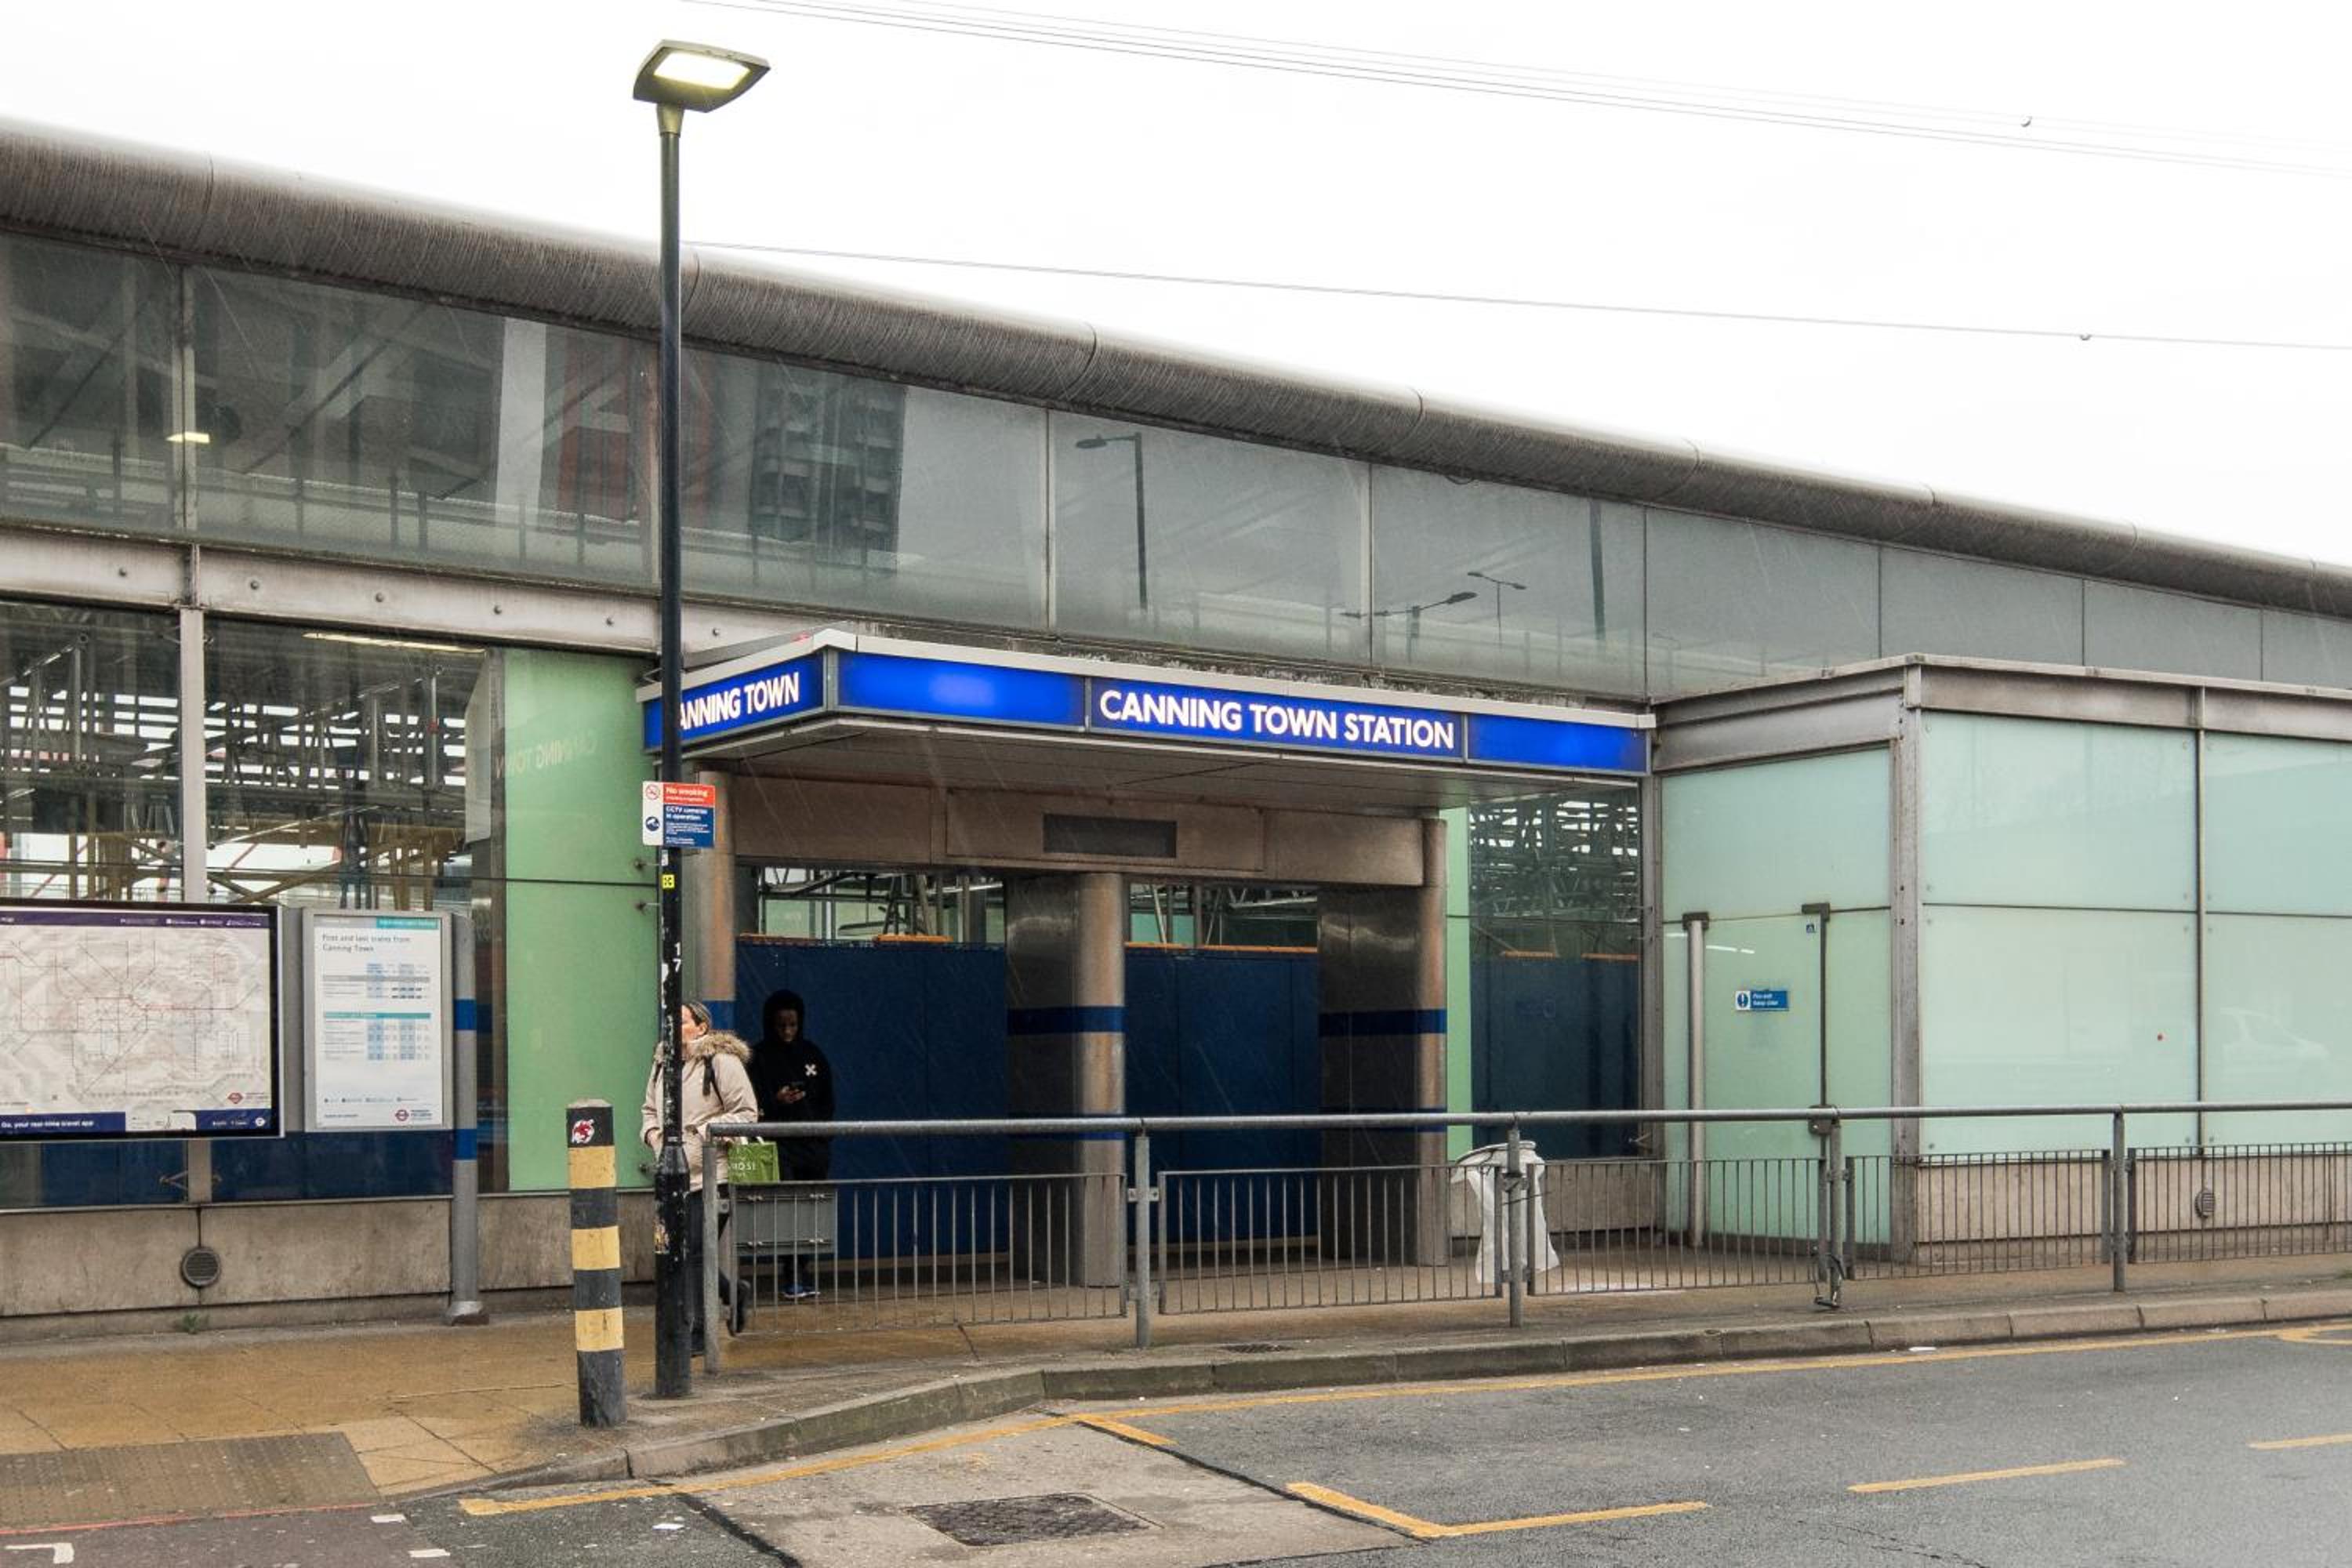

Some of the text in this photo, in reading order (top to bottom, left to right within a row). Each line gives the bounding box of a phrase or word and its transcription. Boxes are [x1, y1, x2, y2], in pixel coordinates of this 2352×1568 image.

[680, 672, 800, 731] ANNING TOWN
[1099, 689, 1454, 750] CANNING TOWN STATION
